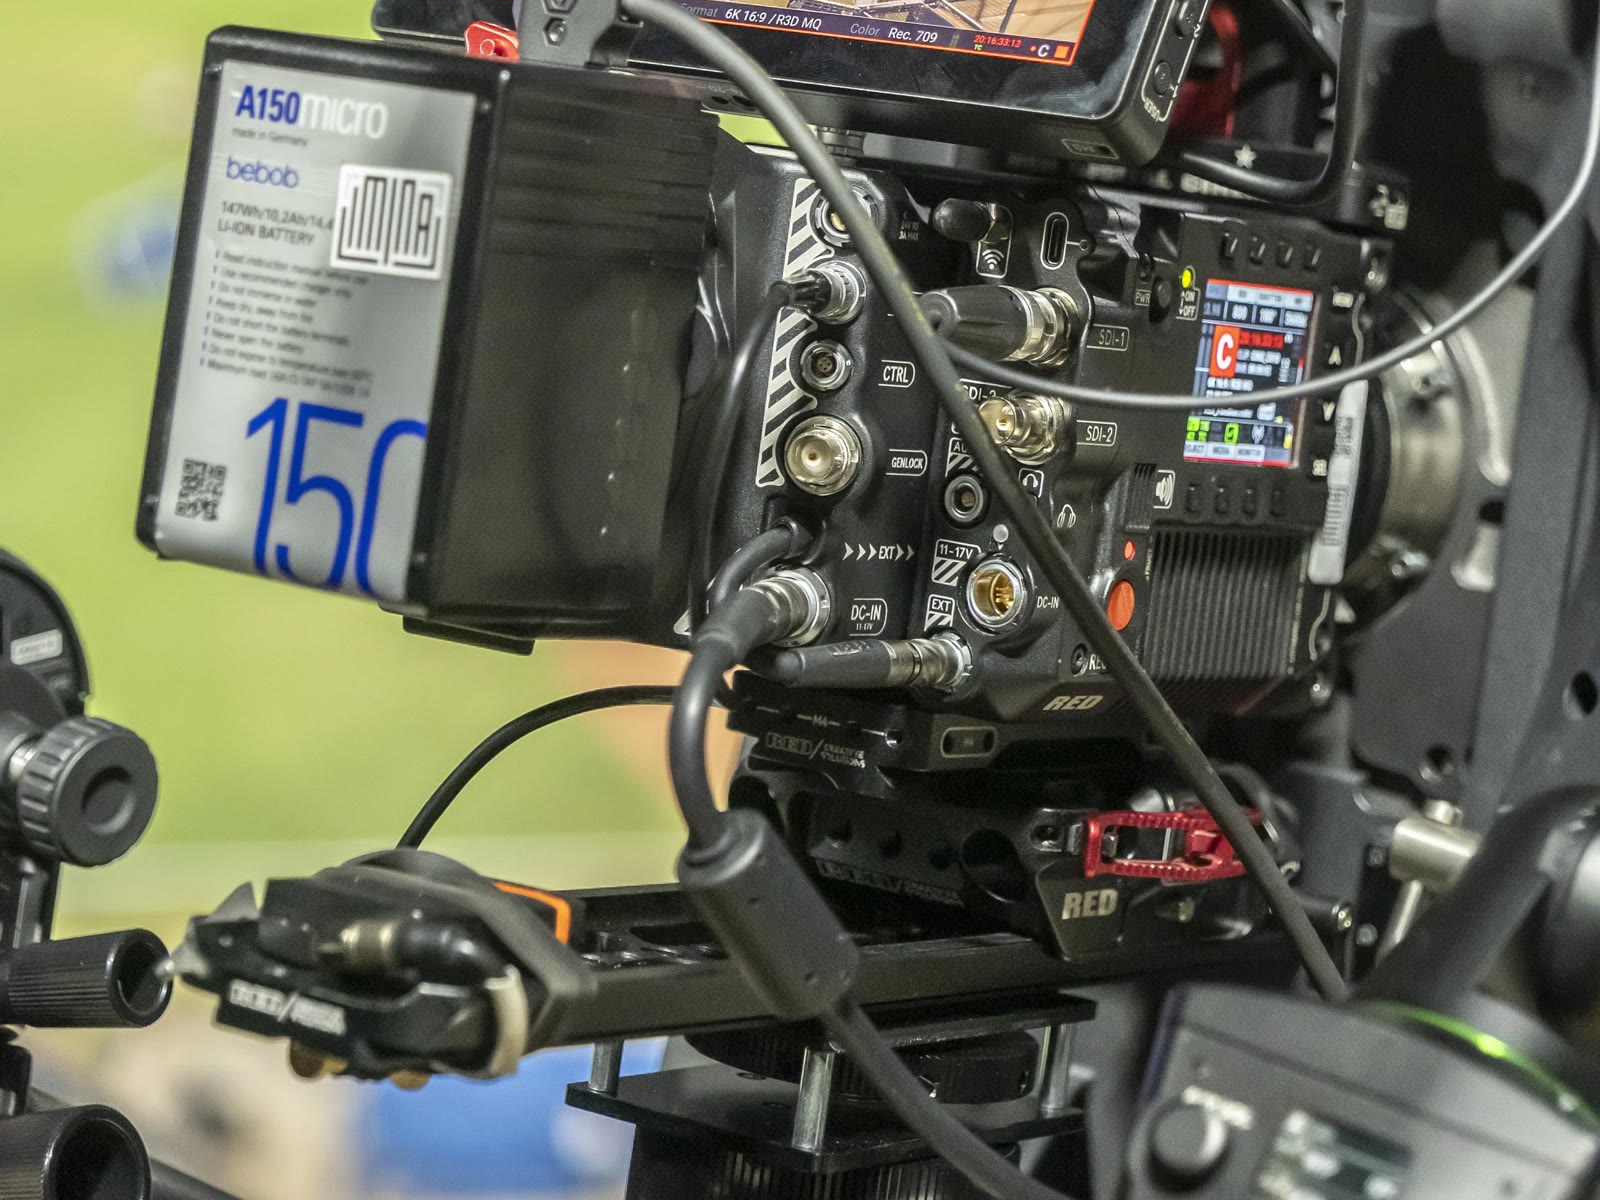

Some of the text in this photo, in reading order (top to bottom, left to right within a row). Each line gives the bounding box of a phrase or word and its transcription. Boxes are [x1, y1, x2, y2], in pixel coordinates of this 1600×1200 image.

[725, 8, 742, 21] 6K
[744, 10, 767, 23] 16:9
[801, 17, 823, 31] MQ
[849, 22, 938, 44] Color Rec. 709
[269, 131, 309, 148] Germany
[226, 156, 299, 189] bebob
[217, 219, 315, 246] LI-ION BATTERY
[1136, 291, 1150, 304] PWR
[1183, 306, 1196, 318] OFF
[1099, 329, 1126, 346] SDI-1
[1216, 333, 1235, 370] C
[883, 365, 909, 383] CTRL
[1086, 426, 1113, 443] SDI-2
[891, 457, 923, 470] GENLOCK
[878, 545, 896, 560] EXT
[939, 543, 974, 560] 11-17V
[931, 599, 950, 613] EXT
[1036, 596, 1059, 609] DC-IN
[850, 604, 882, 621] DC-IN
[1042, 695, 1104, 711] RED
[1061, 888, 1119, 920] RED
